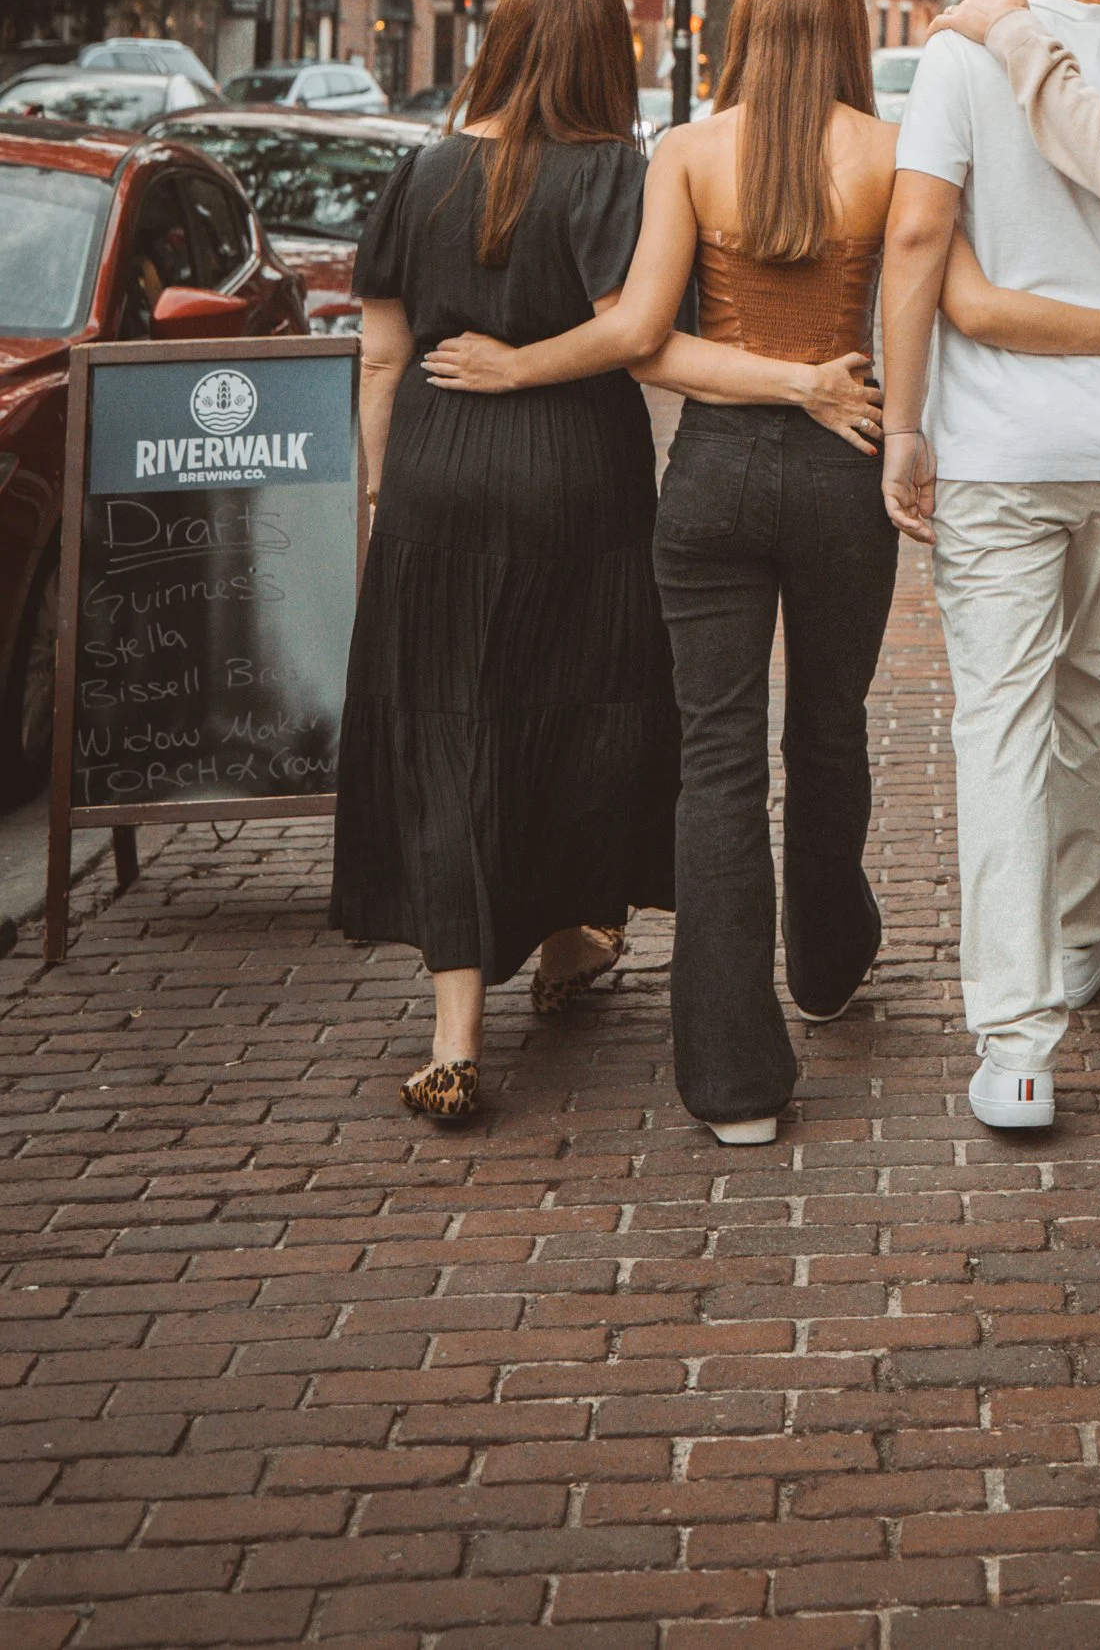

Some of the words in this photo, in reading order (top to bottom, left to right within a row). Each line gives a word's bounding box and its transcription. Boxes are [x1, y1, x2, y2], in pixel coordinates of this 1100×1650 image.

[136, 433, 308, 479] RIVERWALK
[178, 469, 242, 484] BREWING
[243, 468, 267, 480] CO.
[103, 500, 291, 550] Drafts
[83, 573, 286, 625] Guinness
[85, 622, 189, 668] Stella
[81, 666, 200, 708] Bissell
[78, 723, 200, 758] Widow
